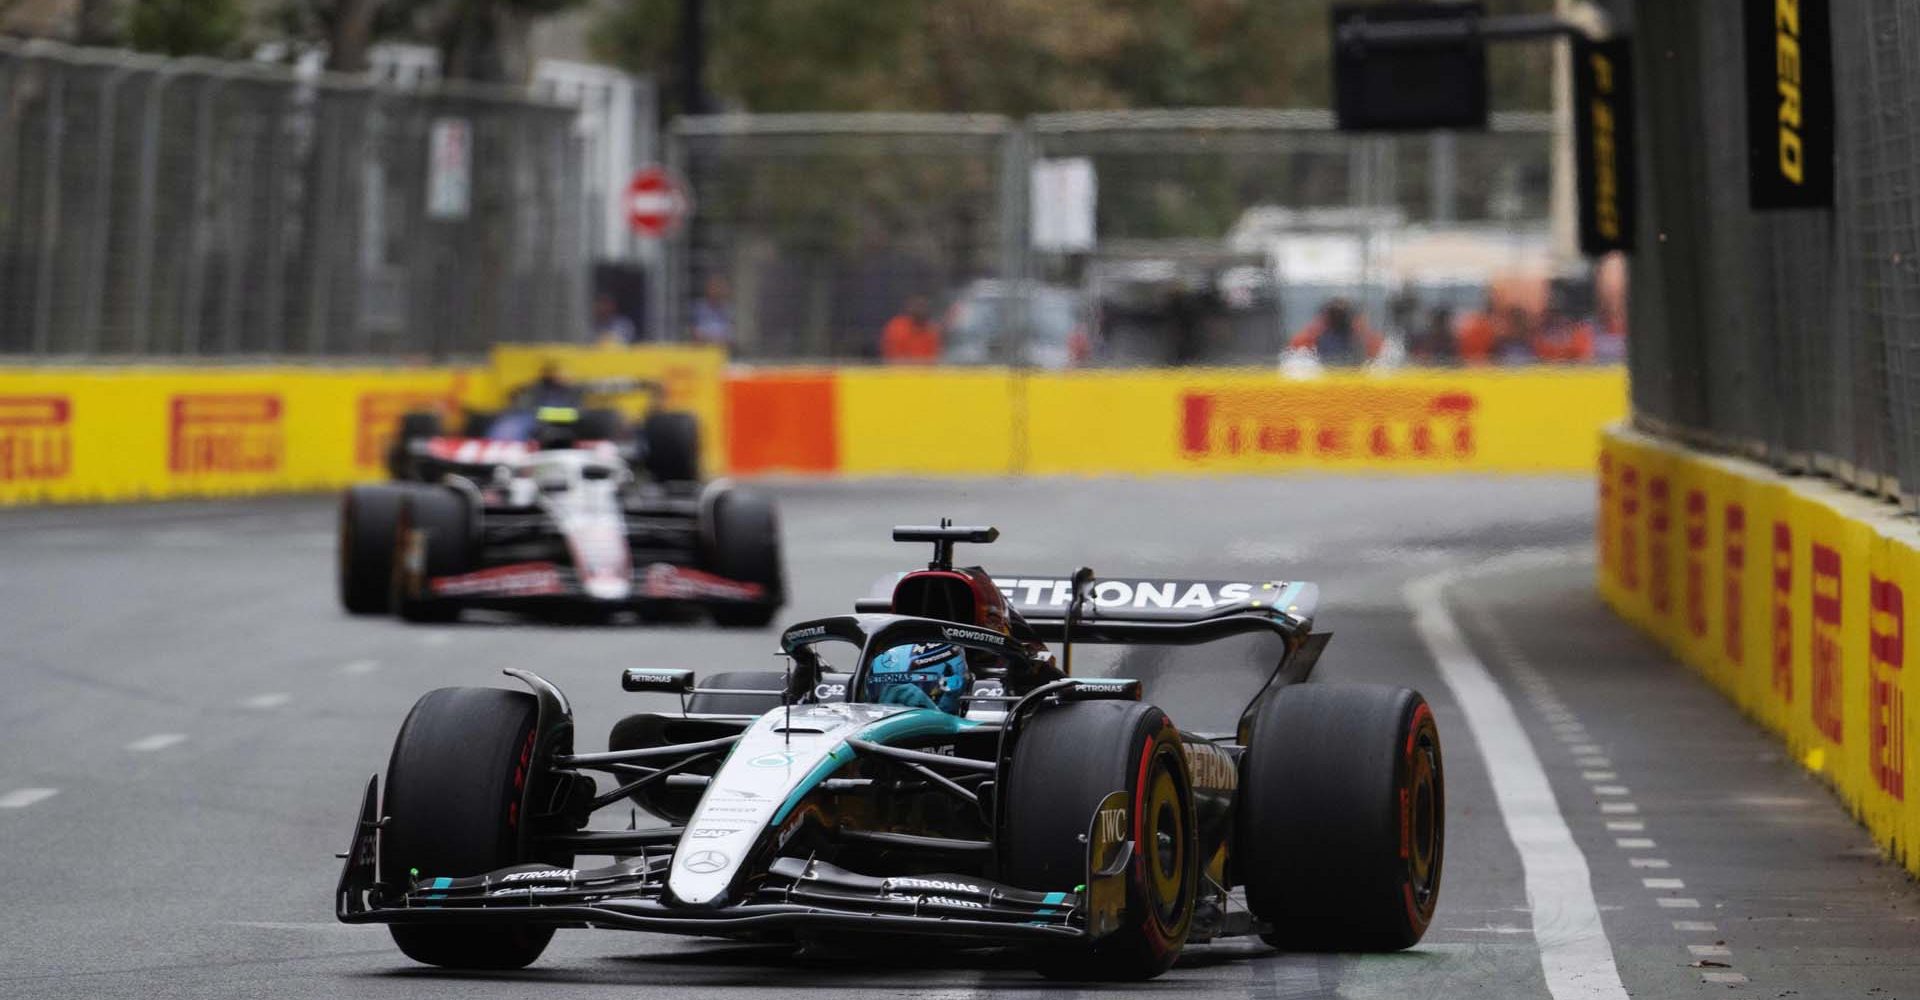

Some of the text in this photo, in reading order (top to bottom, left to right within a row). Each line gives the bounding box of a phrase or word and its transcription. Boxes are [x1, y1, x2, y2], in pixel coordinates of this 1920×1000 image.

[991, 578, 1253, 608] ETRONAS
[945, 627, 1006, 645] CROWDSTRIKE
[631, 674, 672, 683] PETRONAS
[1075, 684, 1122, 692] PETRONAS
[1182, 742, 1239, 790] PETRON
[692, 829, 738, 838] SAP
[1100, 808, 1127, 843] IWC
[502, 869, 580, 882] PETRONAS
[887, 877, 981, 893] PETRONAS
